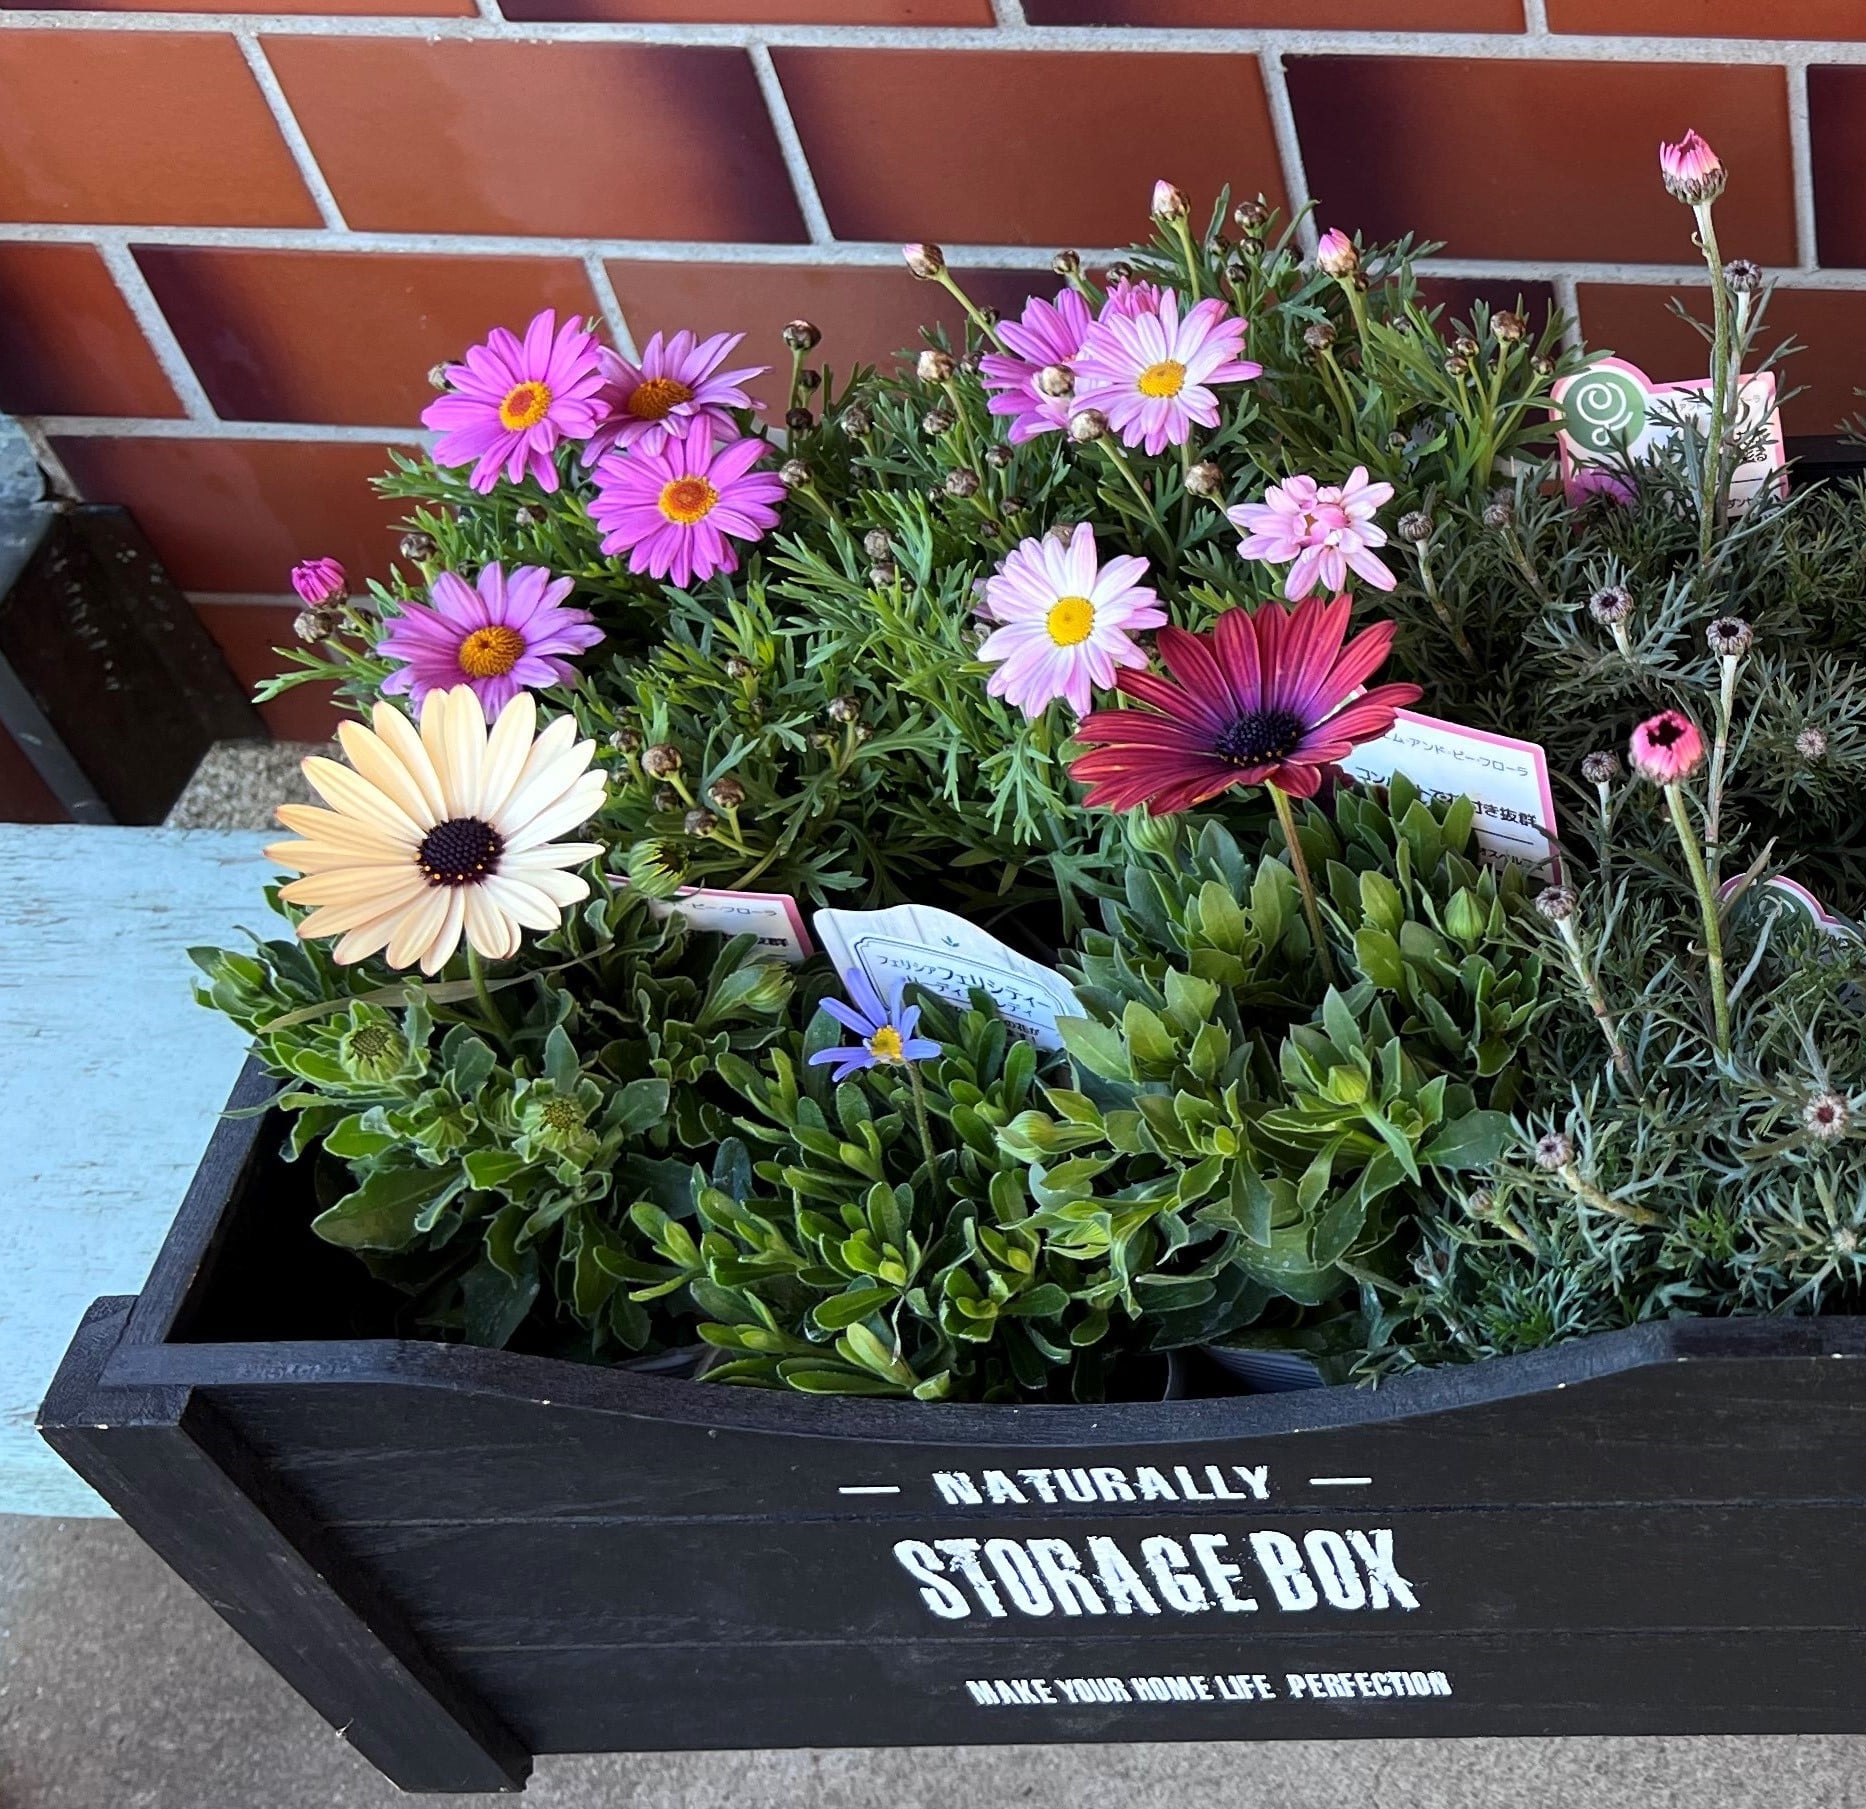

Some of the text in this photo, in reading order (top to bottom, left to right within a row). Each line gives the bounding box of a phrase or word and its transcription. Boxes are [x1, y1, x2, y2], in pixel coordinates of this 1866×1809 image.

[932, 1466, 1270, 1504] NATURALLY
[894, 1529, 1421, 1619] STORAGE BOX
[966, 1670, 1453, 1706] MAKE YOUR HOME LIFE PERFECTION
